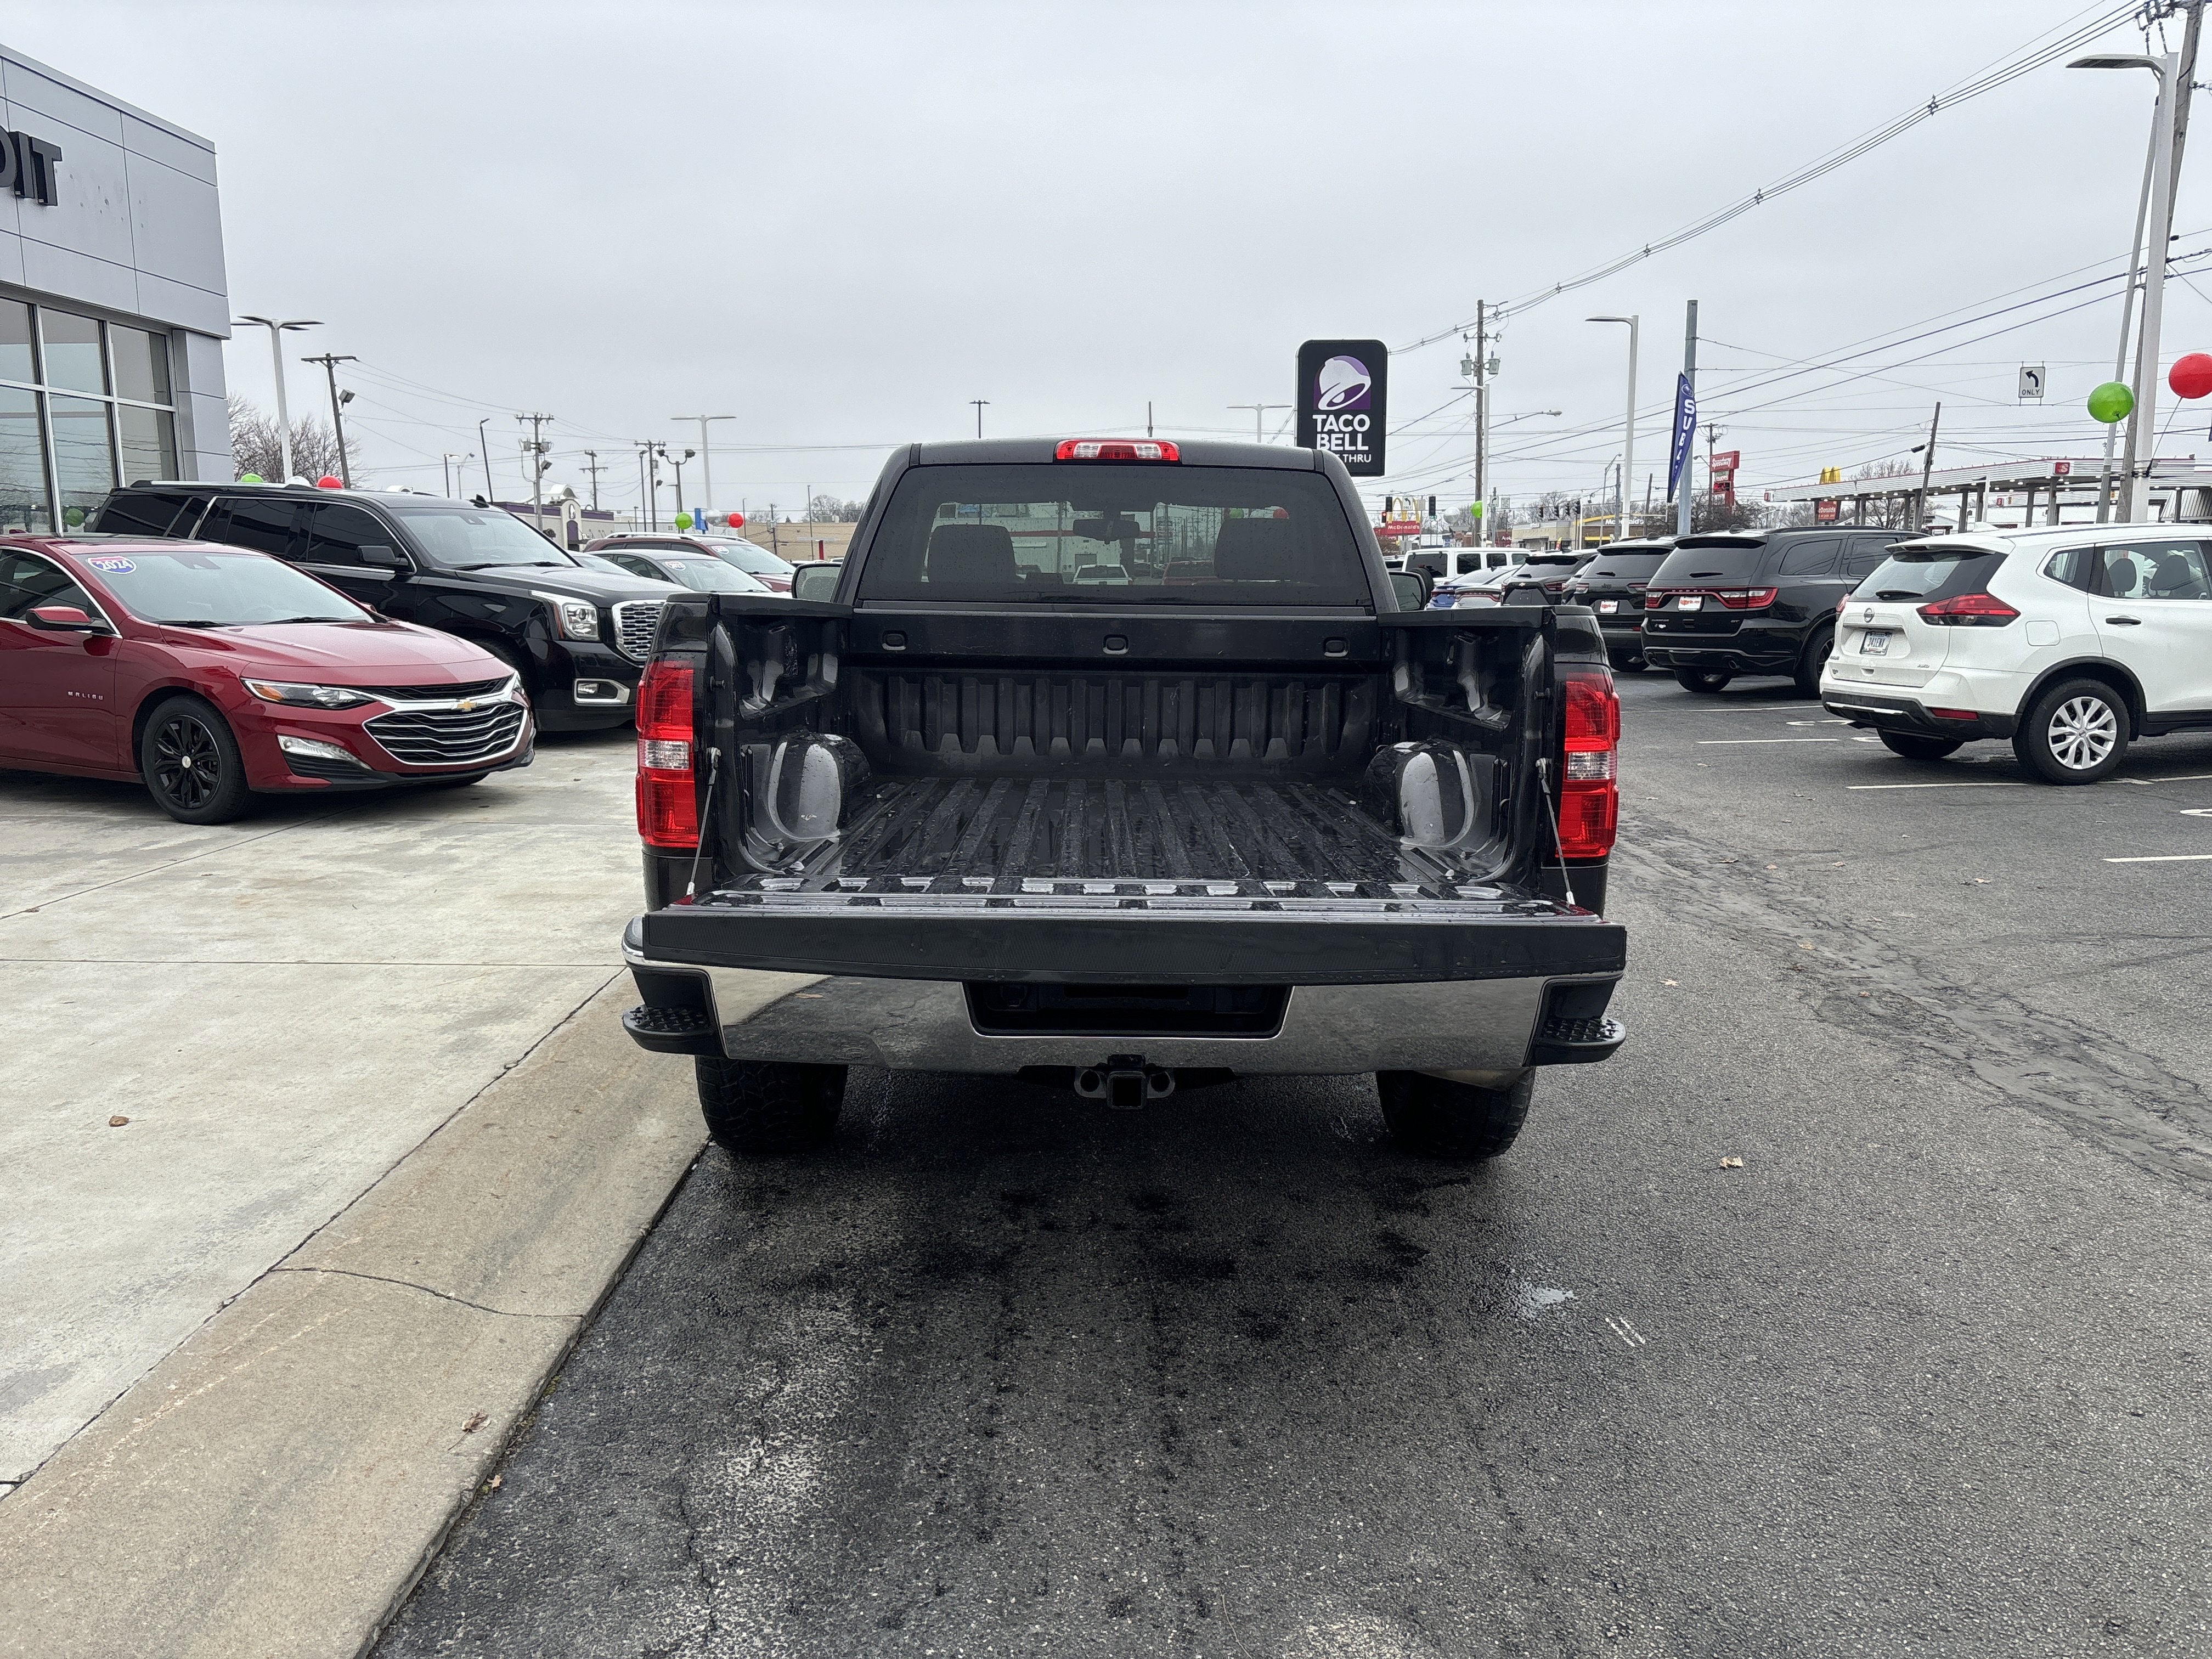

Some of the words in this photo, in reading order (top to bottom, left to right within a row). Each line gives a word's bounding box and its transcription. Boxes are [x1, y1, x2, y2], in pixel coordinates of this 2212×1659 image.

[1312, 414, 1370, 432] TACO
[1317, 433, 1369, 450] BELL
[1342, 454, 1372, 463] THRU
[95, 560, 134, 570] 2024
[67, 691, 103, 700] MALIBU
